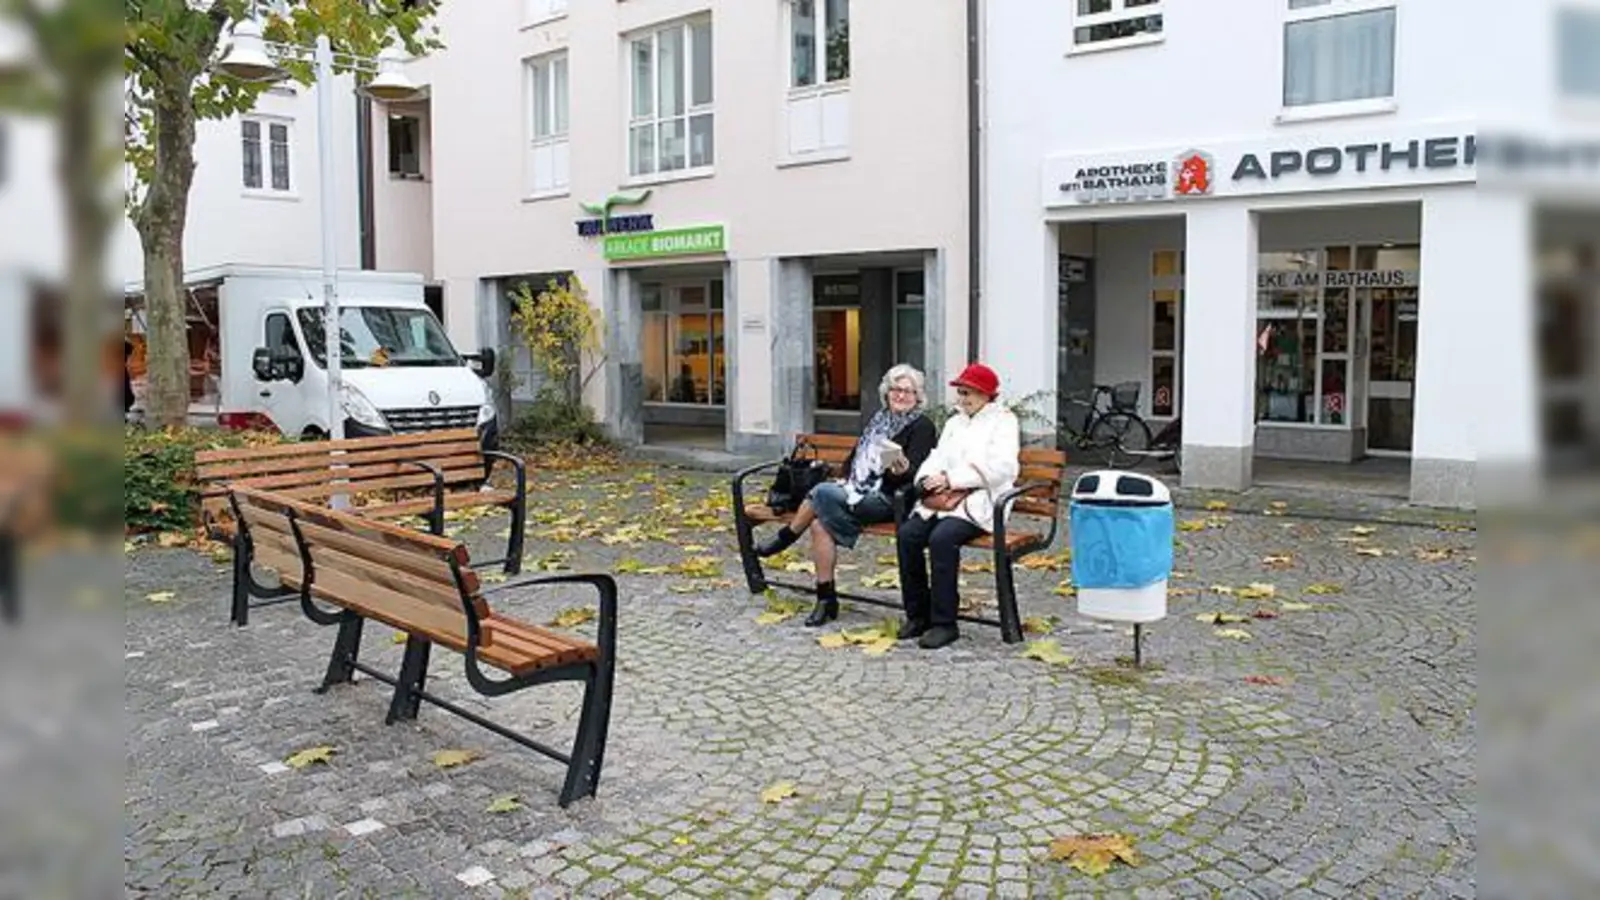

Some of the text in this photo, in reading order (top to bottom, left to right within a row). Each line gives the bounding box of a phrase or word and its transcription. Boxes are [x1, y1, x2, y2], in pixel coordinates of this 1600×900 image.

[1075, 161, 1167, 179] APOTHEKE
[1083, 174, 1167, 190] RATHAUS
[652, 230, 721, 252] BIOMARKT
[1294, 272, 1319, 287] AM
[1326, 270, 1405, 286] RATHAUS
